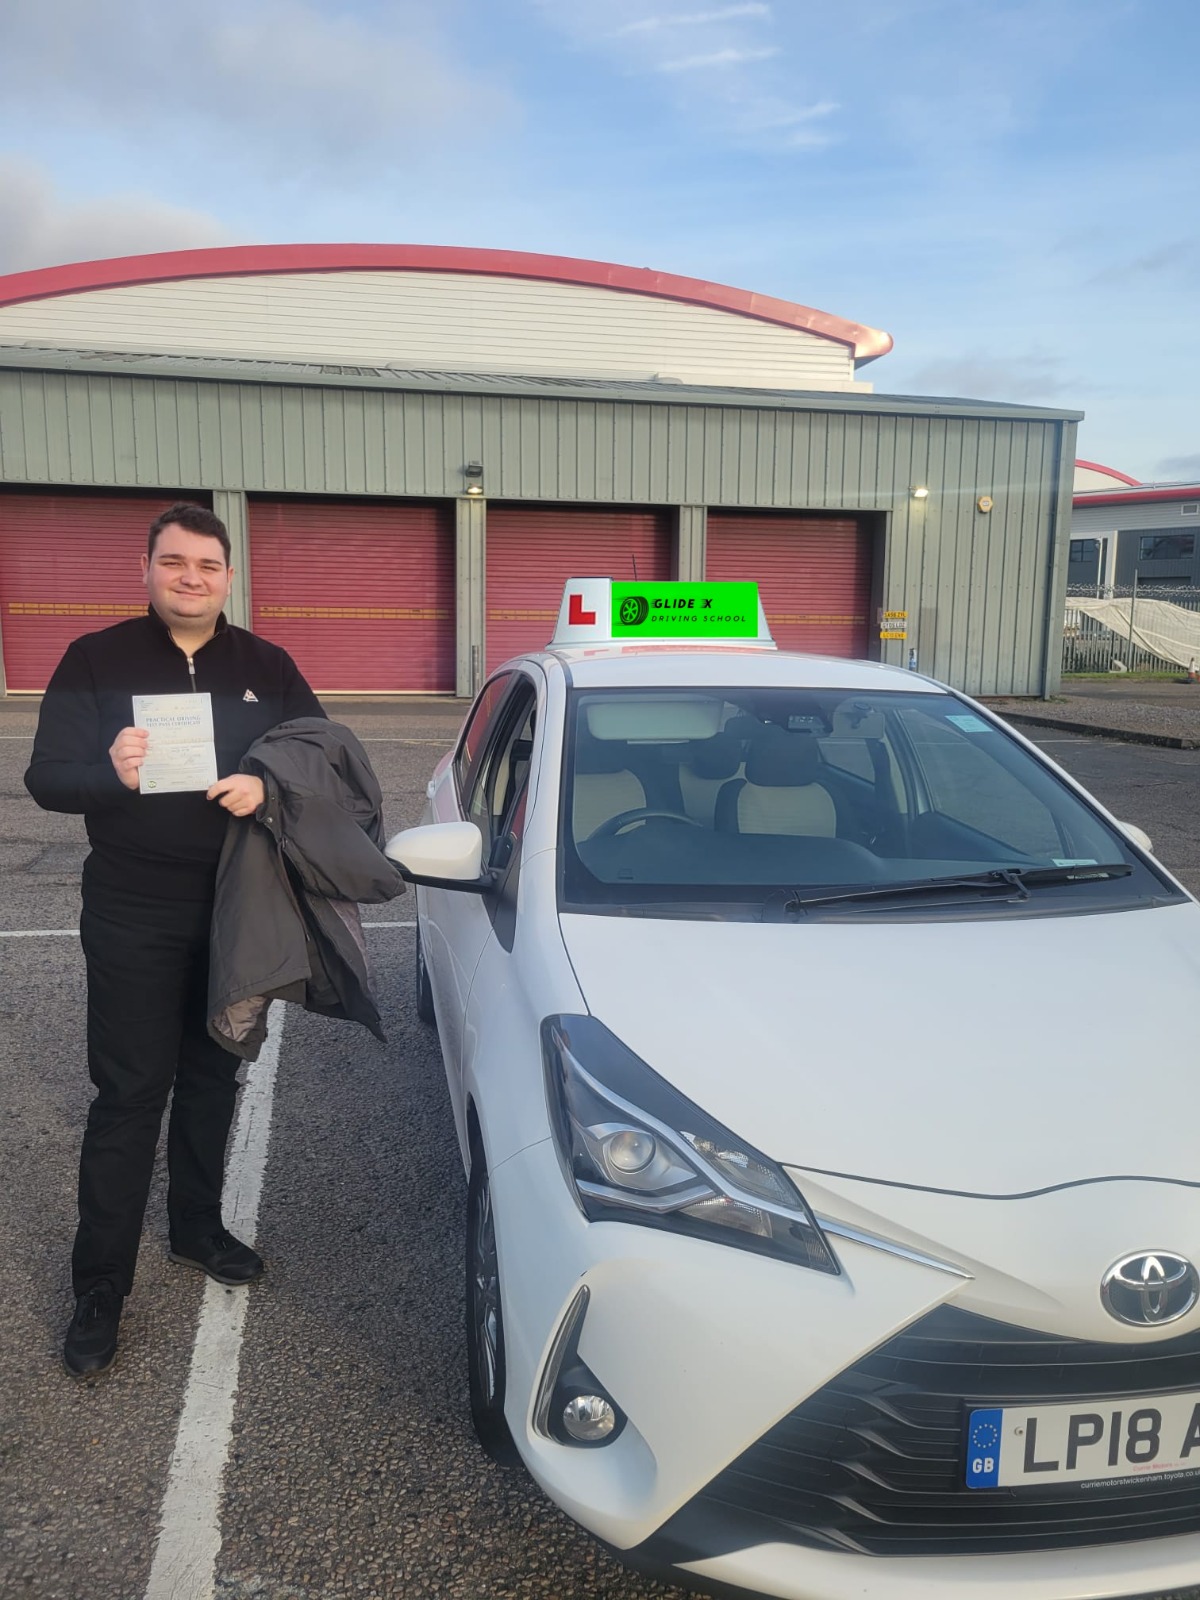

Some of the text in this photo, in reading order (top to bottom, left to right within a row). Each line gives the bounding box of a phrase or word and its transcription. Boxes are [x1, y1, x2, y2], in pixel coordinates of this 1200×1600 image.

[568, 594, 596, 625] L
[653, 598, 713, 609] GLIDE X
[1024, 1408, 1162, 1473] LP18
[972, 1457, 994, 1474] GB
